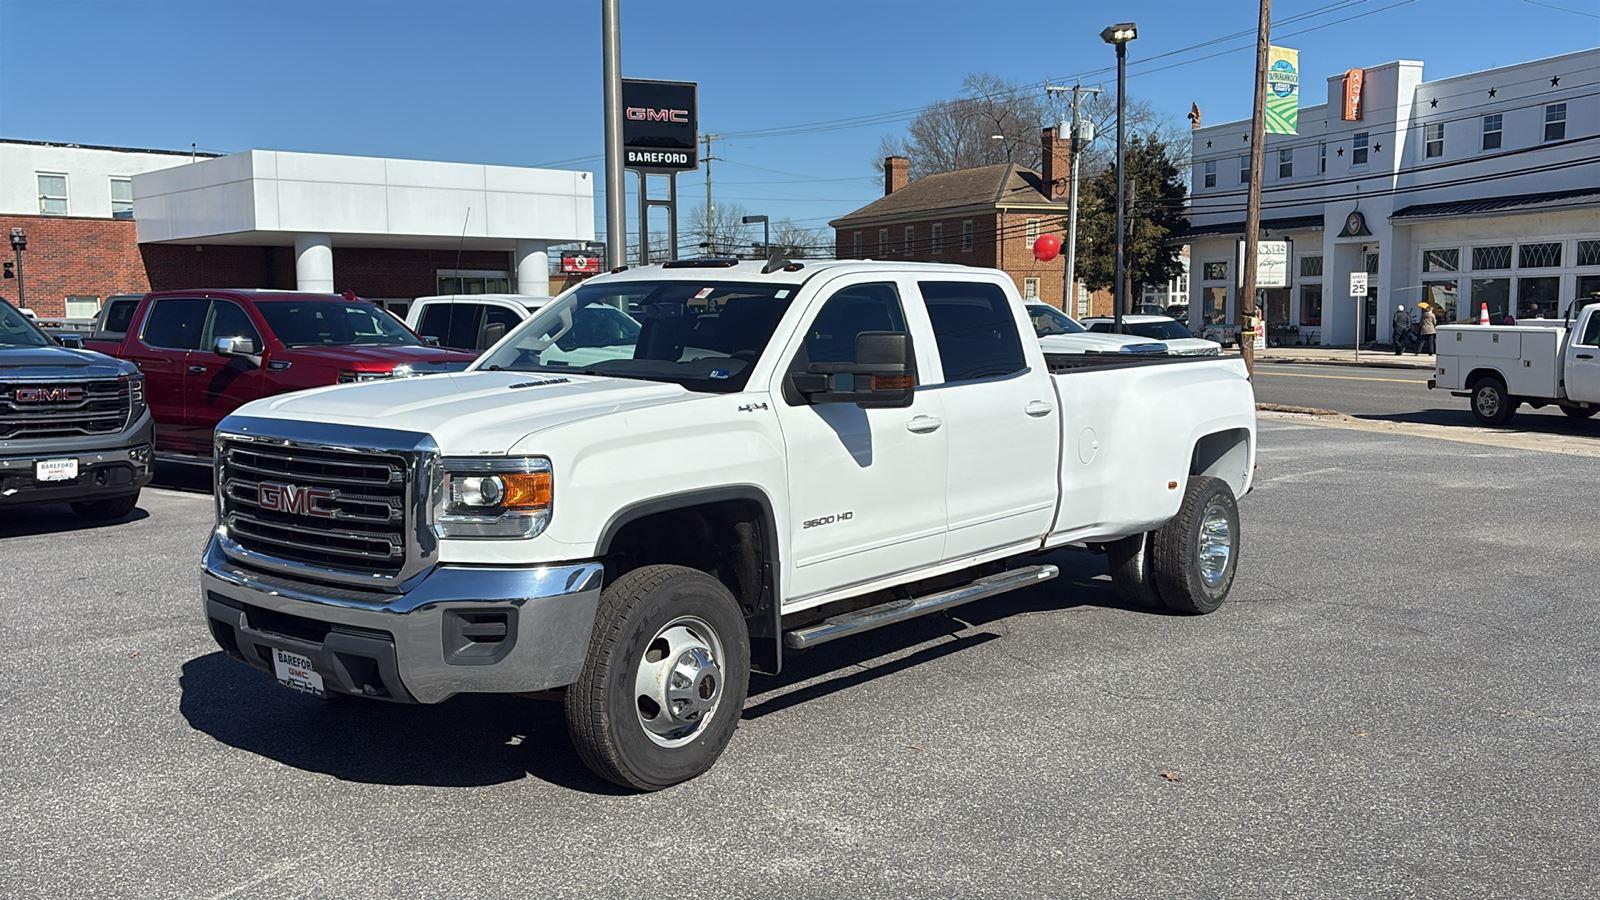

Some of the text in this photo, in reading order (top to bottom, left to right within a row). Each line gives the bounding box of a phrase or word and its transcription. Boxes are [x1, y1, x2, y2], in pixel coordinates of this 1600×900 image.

[626, 107, 688, 123] GMC
[628, 152, 688, 164] BAREFORD
[1352, 284, 1366, 293] 25
[16, 388, 82, 401] GMC
[258, 482, 336, 518] GMC
[837, 511, 853, 522] HD
[278, 652, 313, 670] BAREFOR
[288, 667, 309, 679] GMC
